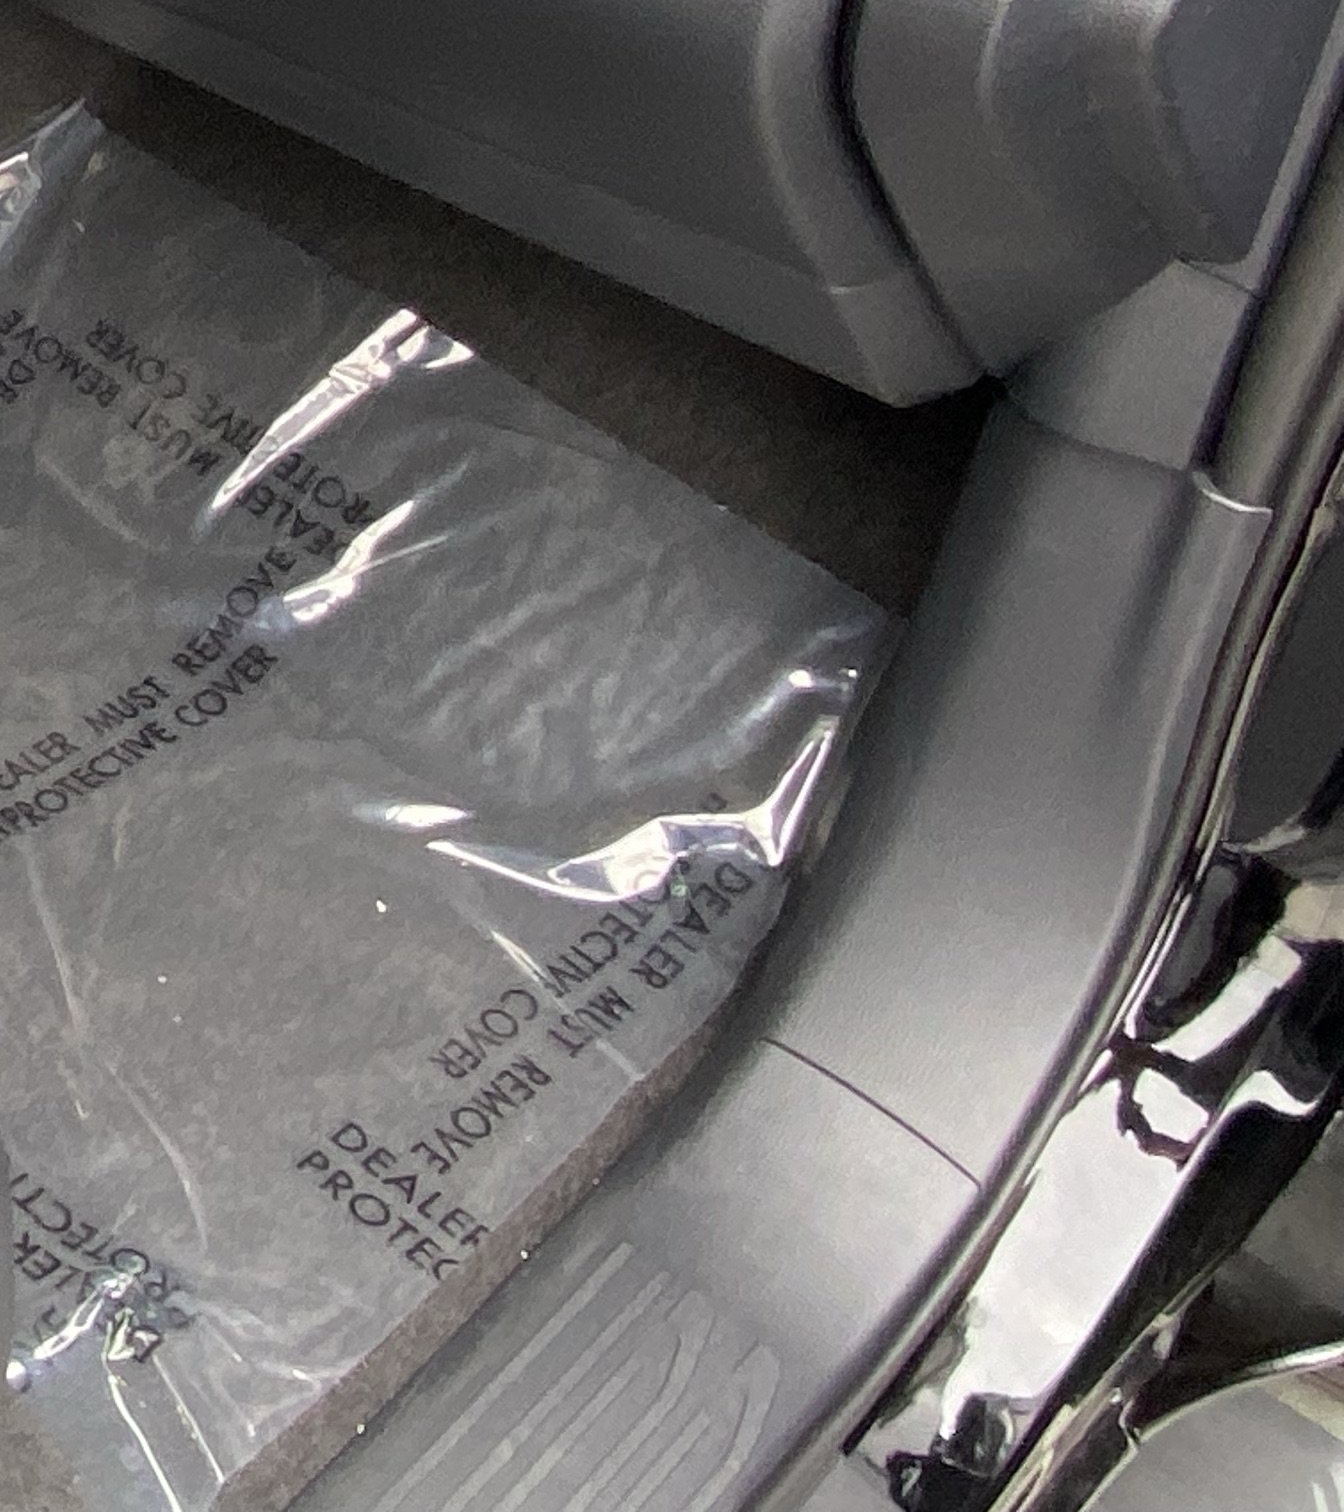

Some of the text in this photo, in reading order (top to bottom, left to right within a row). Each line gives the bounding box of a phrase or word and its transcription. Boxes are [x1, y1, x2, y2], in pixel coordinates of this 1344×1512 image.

[85, 320, 378, 526] ROTETIVE COVER
[127, 403, 220, 476] MUST
[83, 675, 170, 738] MUST
[171, 546, 297, 676] REMOVE
[0, 643, 279, 831] PROTECTIVE COVER
[410, 861, 753, 1176] DEALER MUST REMOVE
[428, 989, 538, 1079] COVER
[13, 1231, 162, 1363] DLER
